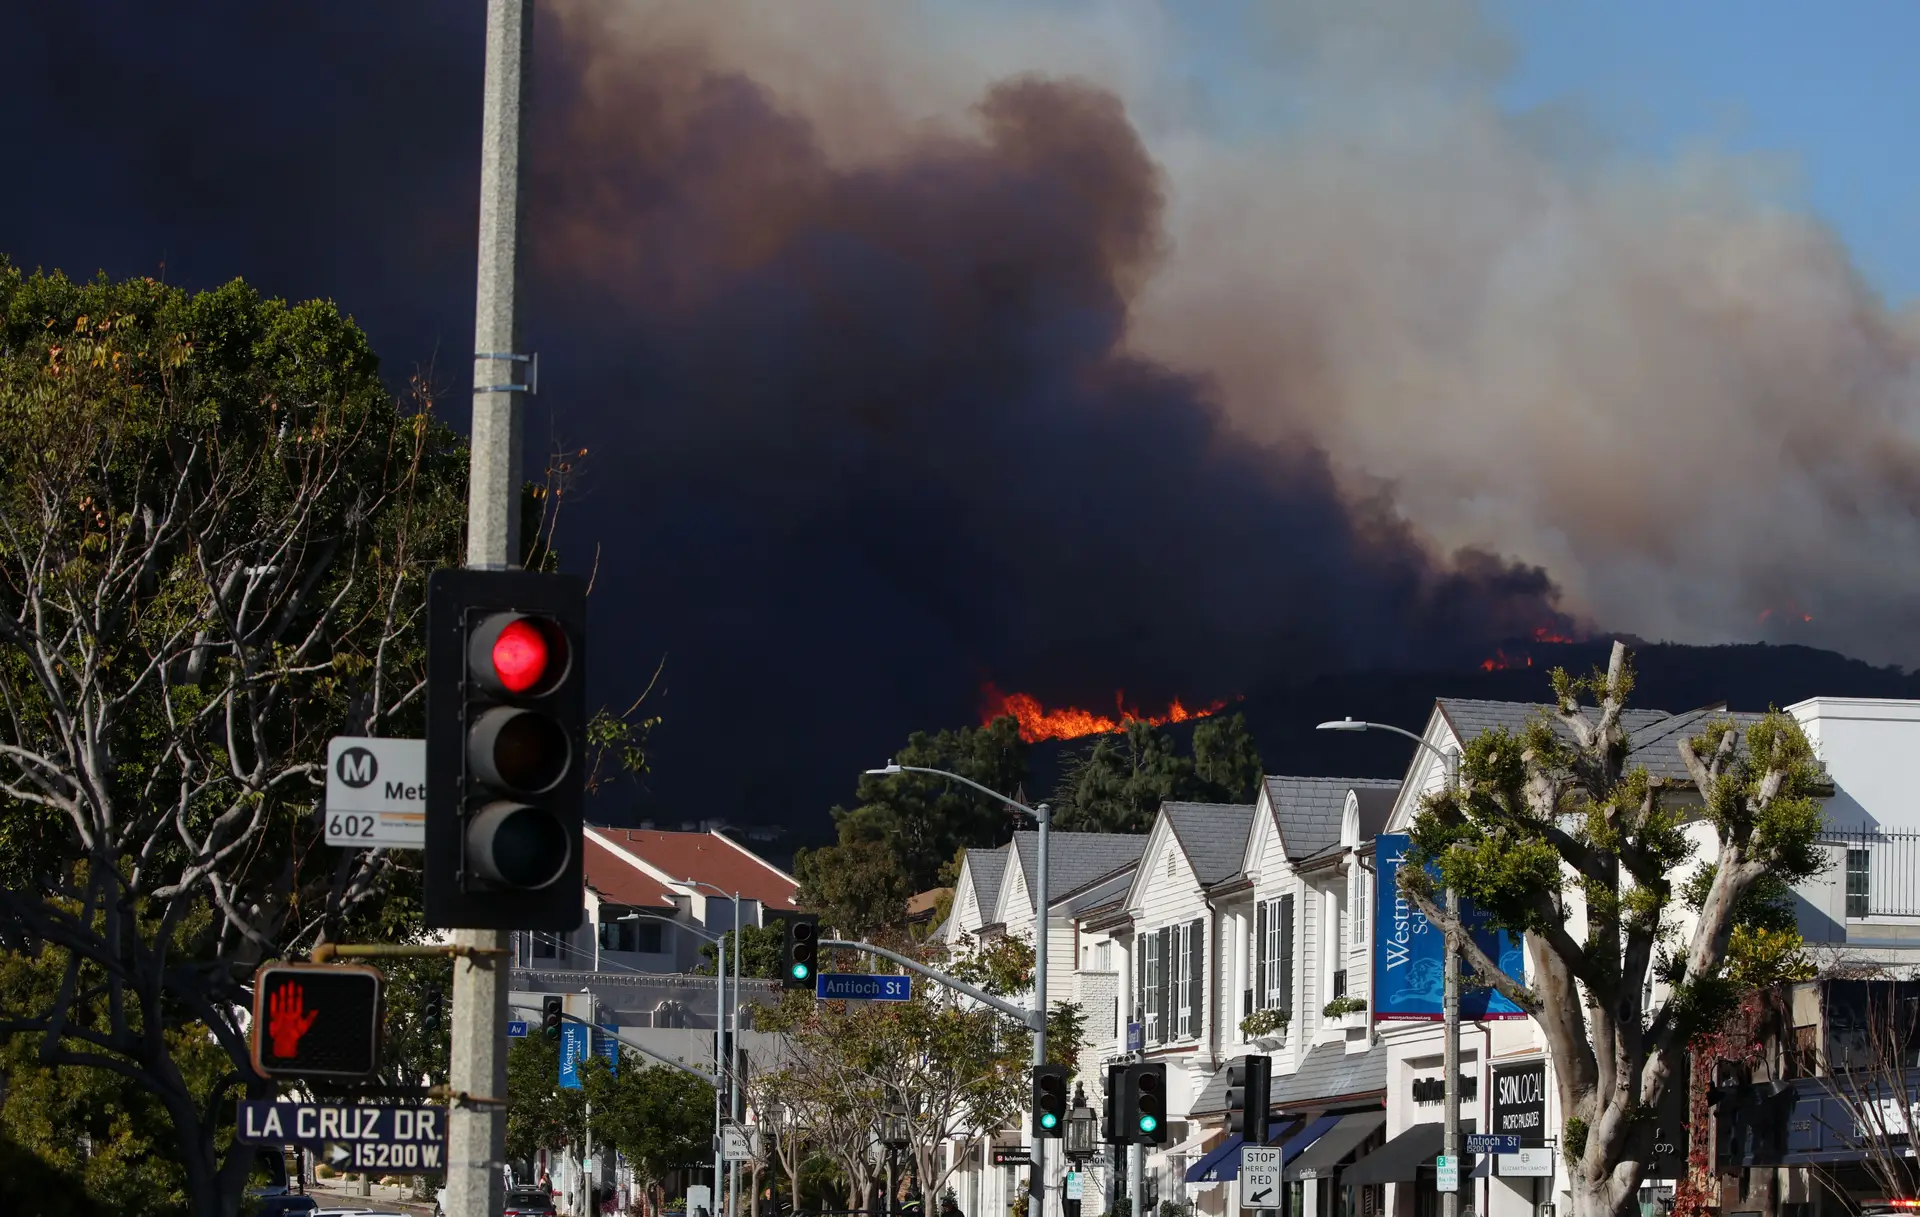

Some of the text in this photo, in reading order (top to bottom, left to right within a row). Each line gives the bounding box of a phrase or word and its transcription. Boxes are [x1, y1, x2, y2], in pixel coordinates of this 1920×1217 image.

[385, 782, 427, 800] Met
[329, 815, 374, 837] 602
[1386, 849, 1409, 971] Westmk
[1412, 908, 1428, 934] Sch
[826, 980, 901, 994] Antioch St
[511, 1025, 521, 1034] Av
[563, 1028, 575, 1075] Westmark
[246, 1106, 443, 1141] LA CRUZ DR.
[731, 1139, 748, 1147] MUS
[1467, 1135, 1517, 1147] Antioch St
[355, 1143, 442, 1168] 15200 W.
[1466, 1145, 1485, 1153] 15200
[1067, 1156, 1105, 1165] EWHON
[1247, 1152, 1276, 1163] STOP
[1439, 1157, 1444, 1166] 2
[1250, 1175, 1272, 1185] RED
